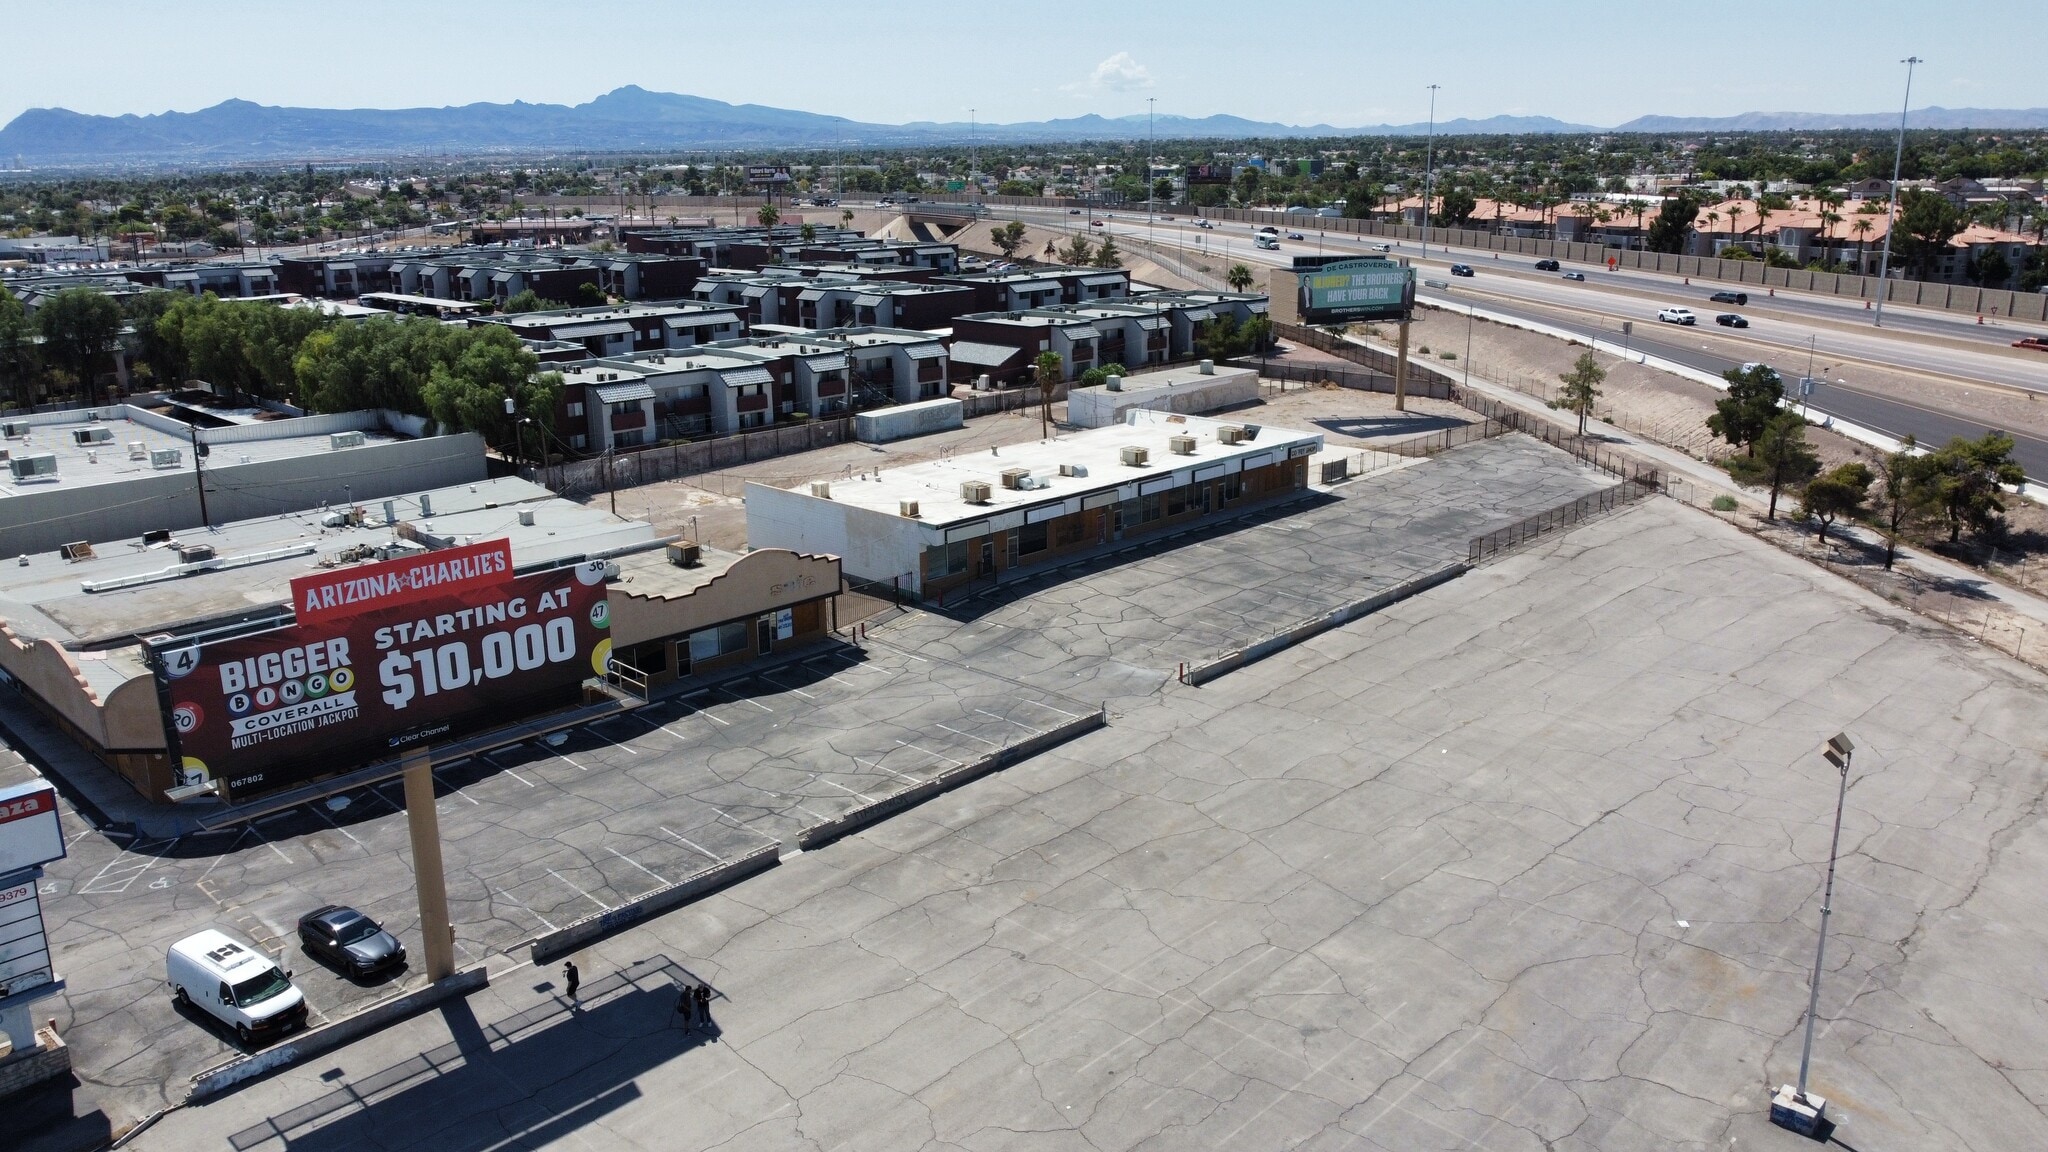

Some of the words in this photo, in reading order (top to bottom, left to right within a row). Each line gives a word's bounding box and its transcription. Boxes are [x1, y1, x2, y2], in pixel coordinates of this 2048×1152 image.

[1327, 289, 1347, 302] HAVE
[1348, 288, 1368, 301] YOUR
[1368, 287, 1389, 300] BACK
[1352, 274, 1366, 286] THE
[1366, 272, 1404, 286] BROTHERS
[305, 572, 401, 613] ARIZONA
[409, 551, 506, 590] CHARLIE'S
[374, 598, 527, 650] STARTING
[537, 587, 572, 613] AT
[592, 605, 604, 619] 47
[219, 636, 353, 695] BIGGER
[378, 616, 577, 710] $10,000
[234, 671, 347, 710] BINGO
[231, 718, 315, 750] MULTI-LOCATION
[318, 706, 360, 728] JACKPOT
[244, 698, 344, 730] COVERALL
[400, 733, 420, 743] Clear
[420, 724, 450, 738] Channel
[230, 773, 264, 788] 067802
